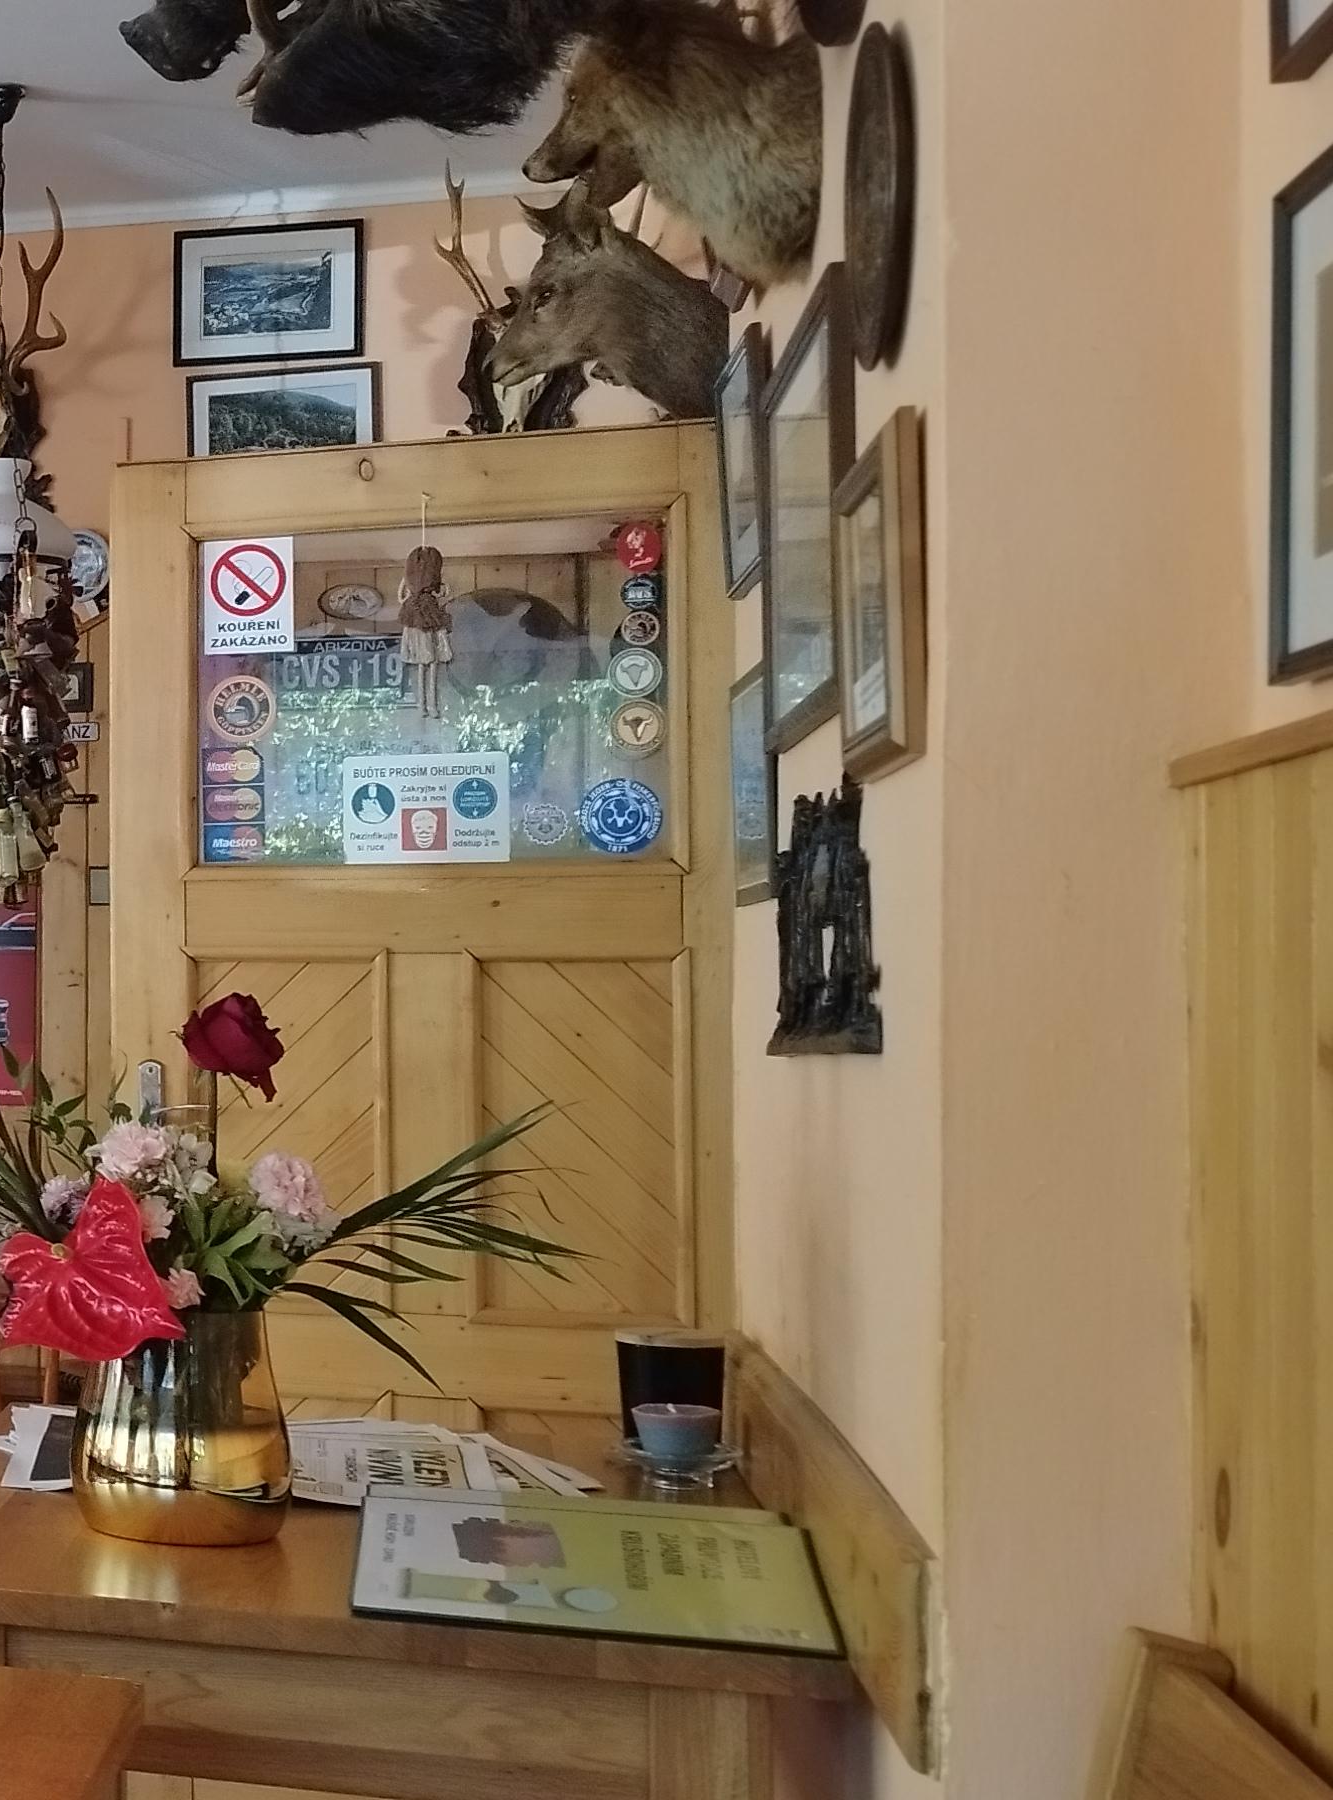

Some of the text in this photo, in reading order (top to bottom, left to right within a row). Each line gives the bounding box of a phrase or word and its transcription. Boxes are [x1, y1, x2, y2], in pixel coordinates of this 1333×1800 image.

[217, 618, 281, 633] KOUŘENÍ
[210, 634, 288, 648] ZAKÁZÁNO
[313, 640, 388, 652] ARIZONA
[283, 654, 341, 690] CVS
[353, 762, 496, 779] BUĎTE PROSÍM OHLEDUPLNÍ
[400, 784, 447, 794] Zakryjte si
[349, 832, 399, 842] Dezinfikujte
[454, 829, 496, 840] Dodržujte
[212, 837, 258, 849] Maestro
[356, 844, 385, 852] si ruce
[452, 839, 482, 849] odstup
